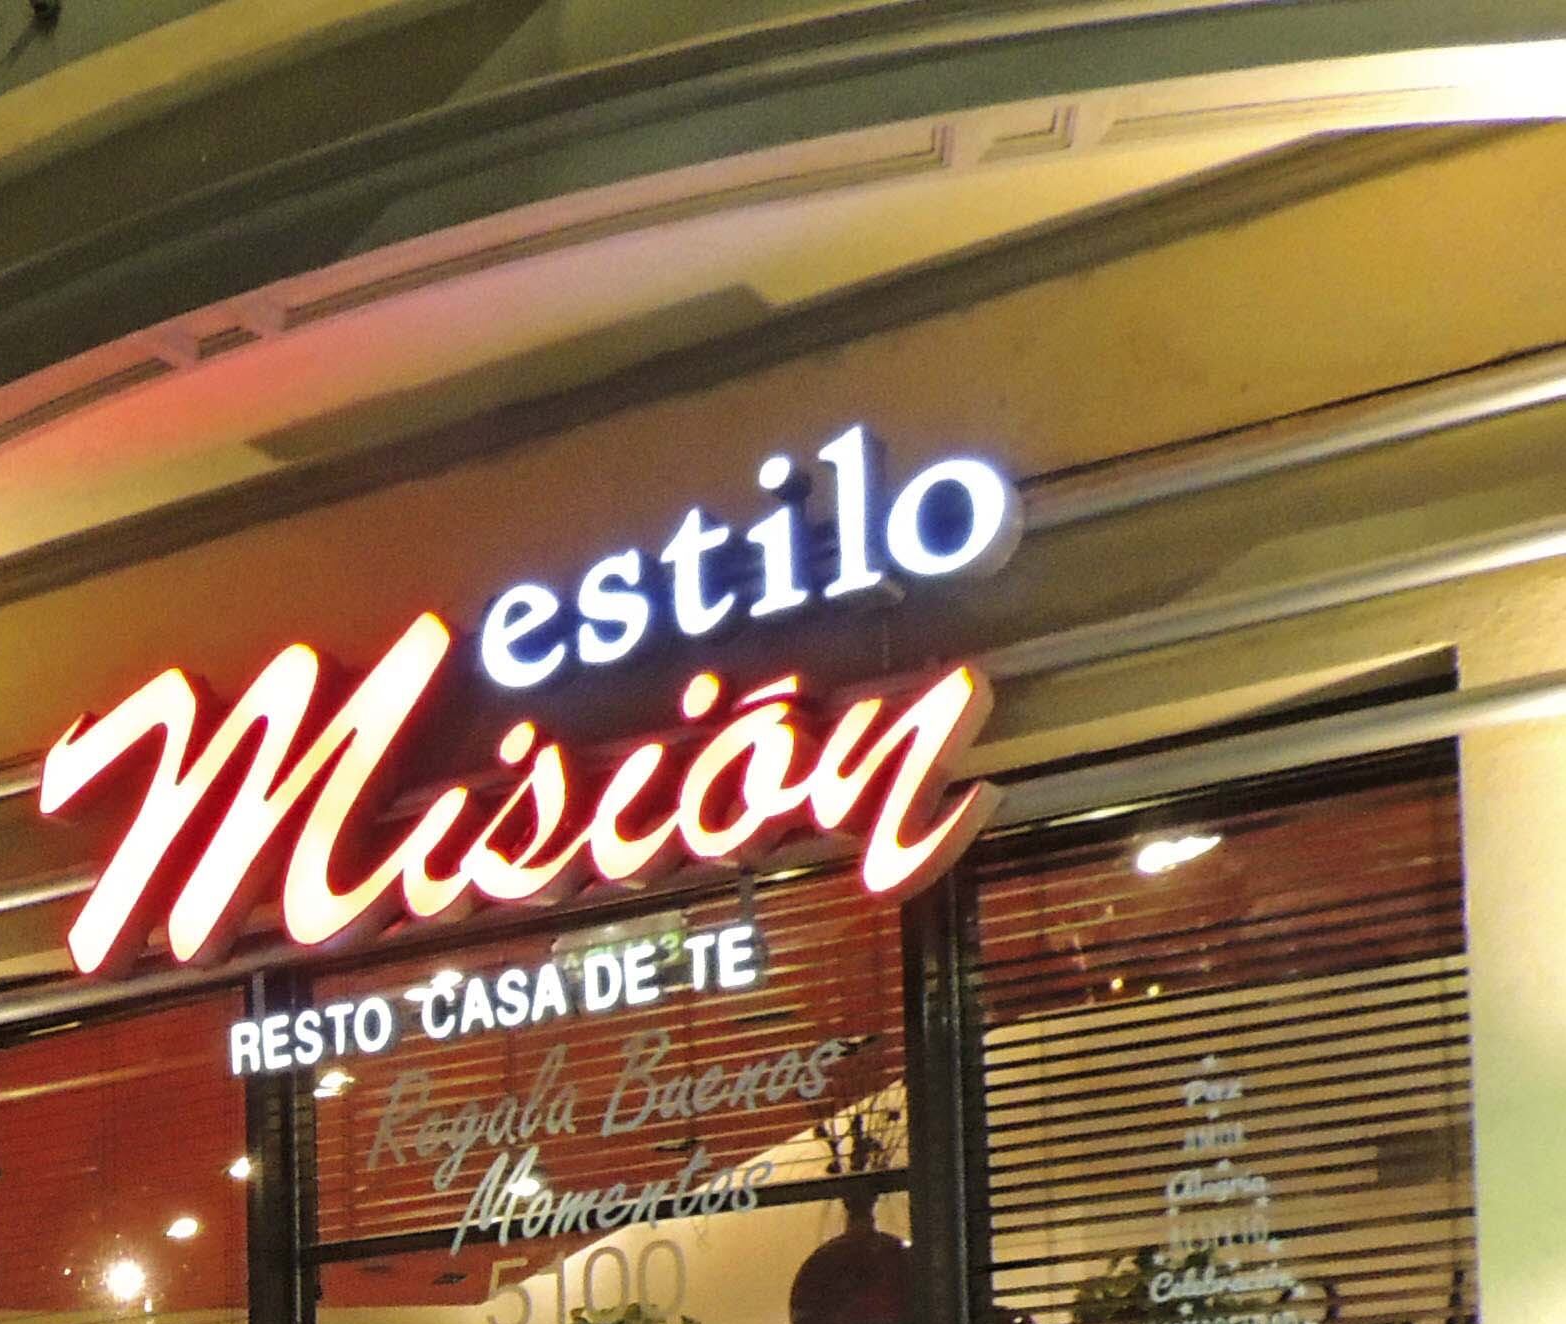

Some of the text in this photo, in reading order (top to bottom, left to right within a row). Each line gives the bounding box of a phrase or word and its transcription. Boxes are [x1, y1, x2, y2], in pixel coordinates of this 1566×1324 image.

[479, 424, 1008, 688] estilo
[38, 610, 984, 975] Misión
[231, 998, 393, 1076] RESTO
[421, 963, 568, 1040] CASA
[584, 943, 661, 1012] DE
[684, 925, 757, 991] TE
[368, 1029, 841, 1191] Regala Buenos
[452, 1147, 773, 1256] Momentos
